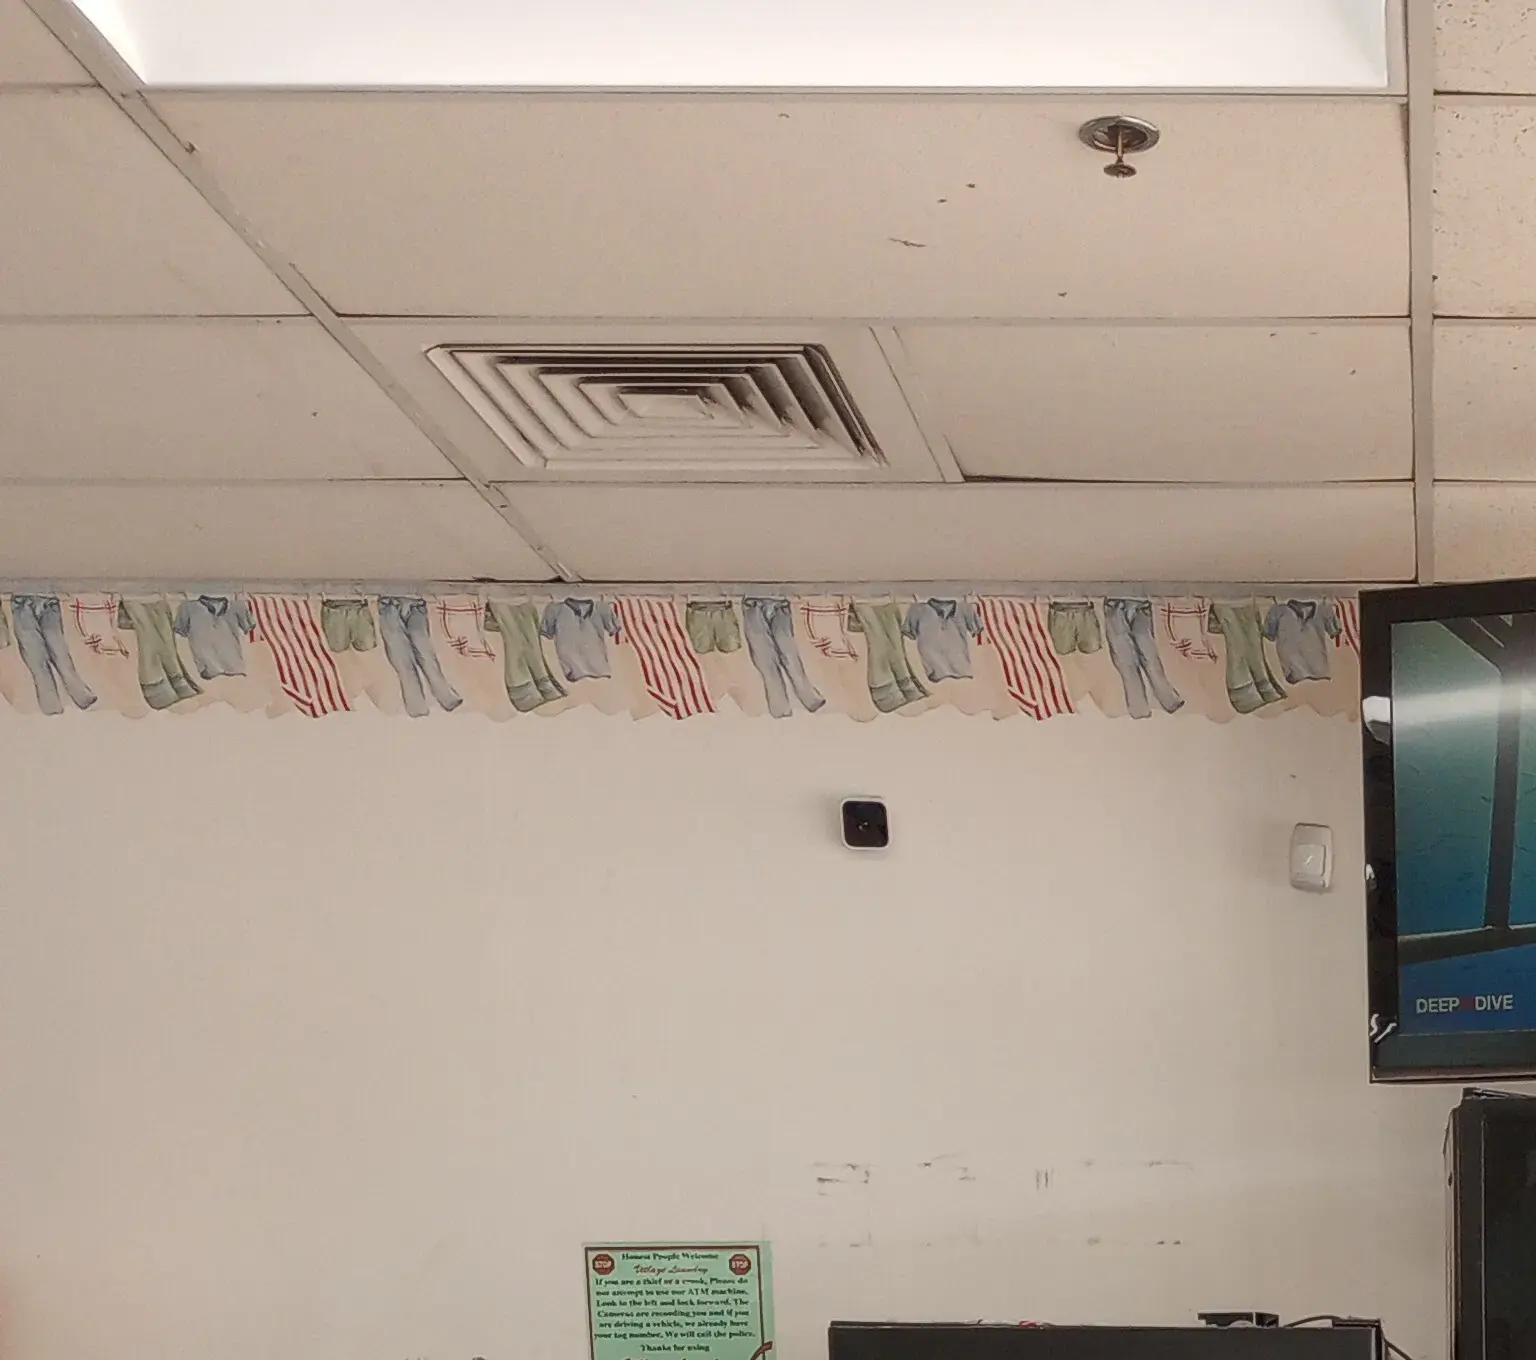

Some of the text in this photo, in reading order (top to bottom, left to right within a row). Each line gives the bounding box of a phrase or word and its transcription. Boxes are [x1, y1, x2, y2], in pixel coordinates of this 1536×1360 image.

[1416, 995, 1514, 1014] DEEP DIVE
[653, 1253, 679, 1261] People
[688, 1288, 709, 1296] ATM
[733, 1298, 749, 1306] The
[614, 1320, 643, 1329] driving
[697, 1320, 727, 1329] already
[614, 1332, 627, 1340] tag
[680, 1330, 695, 1338] will
[640, 1344, 672, 1352] Thanks
[687, 1344, 710, 1352] using
